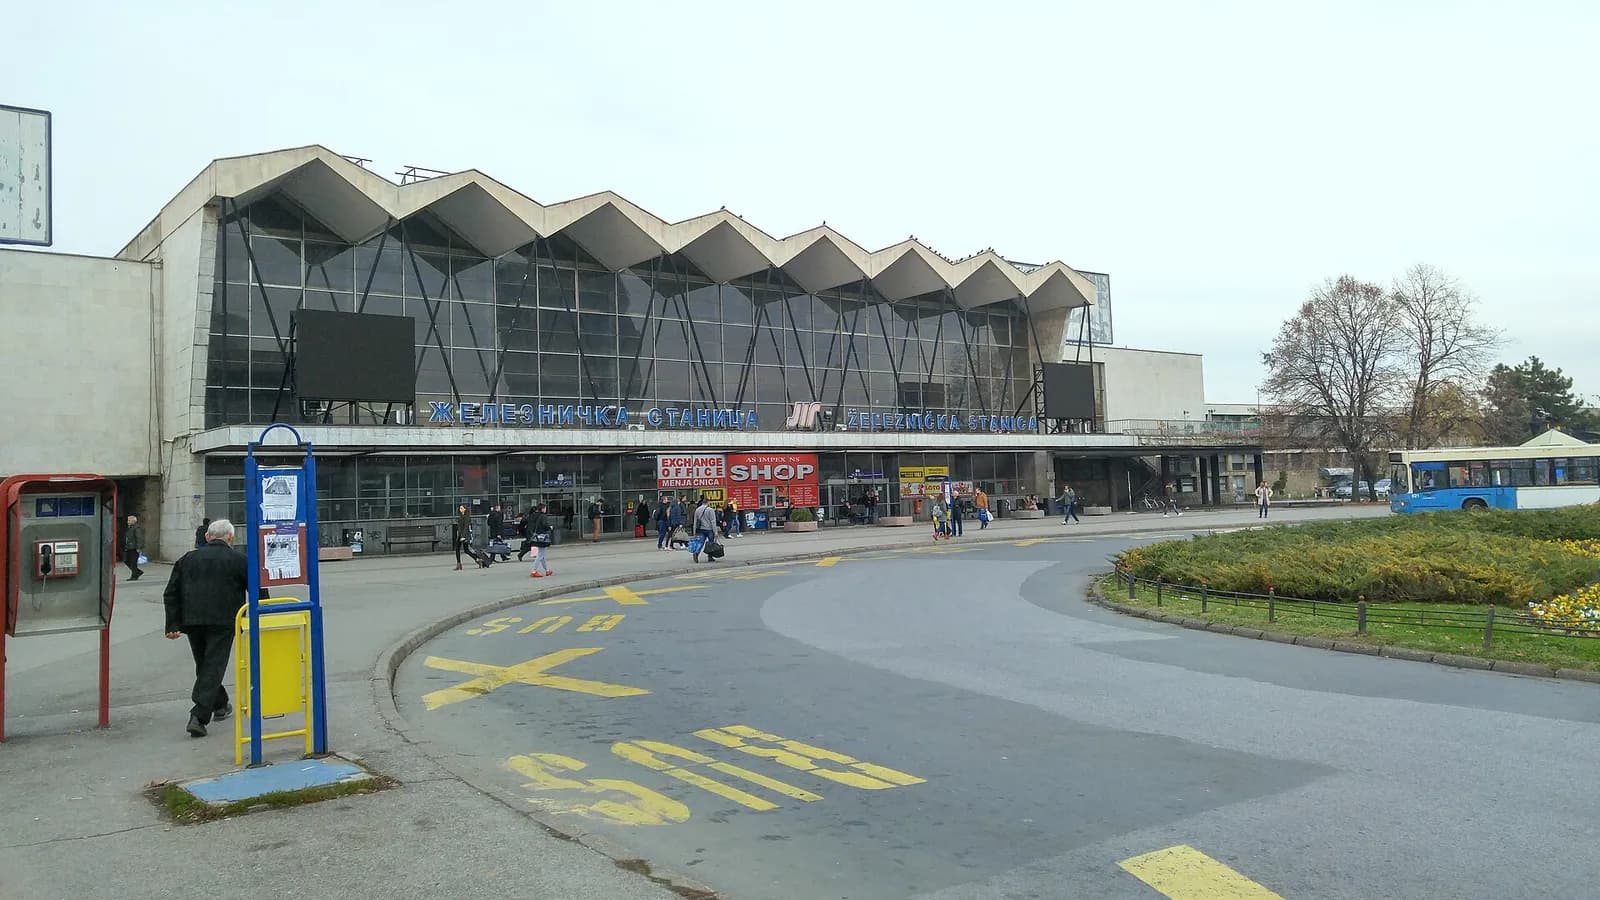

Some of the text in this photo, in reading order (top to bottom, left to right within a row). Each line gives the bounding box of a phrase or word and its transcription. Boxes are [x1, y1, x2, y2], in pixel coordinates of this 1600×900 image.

[429, 401, 759, 430] ЖЕЛЕЗНИЧКА СТАНИЦА
[847, 408, 1038, 432] ŽELEZNIČKA STANICA
[661, 457, 723, 468] EXCHANGE
[661, 467, 723, 477] OFFICE
[729, 464, 815, 482] SHOP
[465, 614, 626, 636] BUS
[506, 724, 928, 826] BUS
